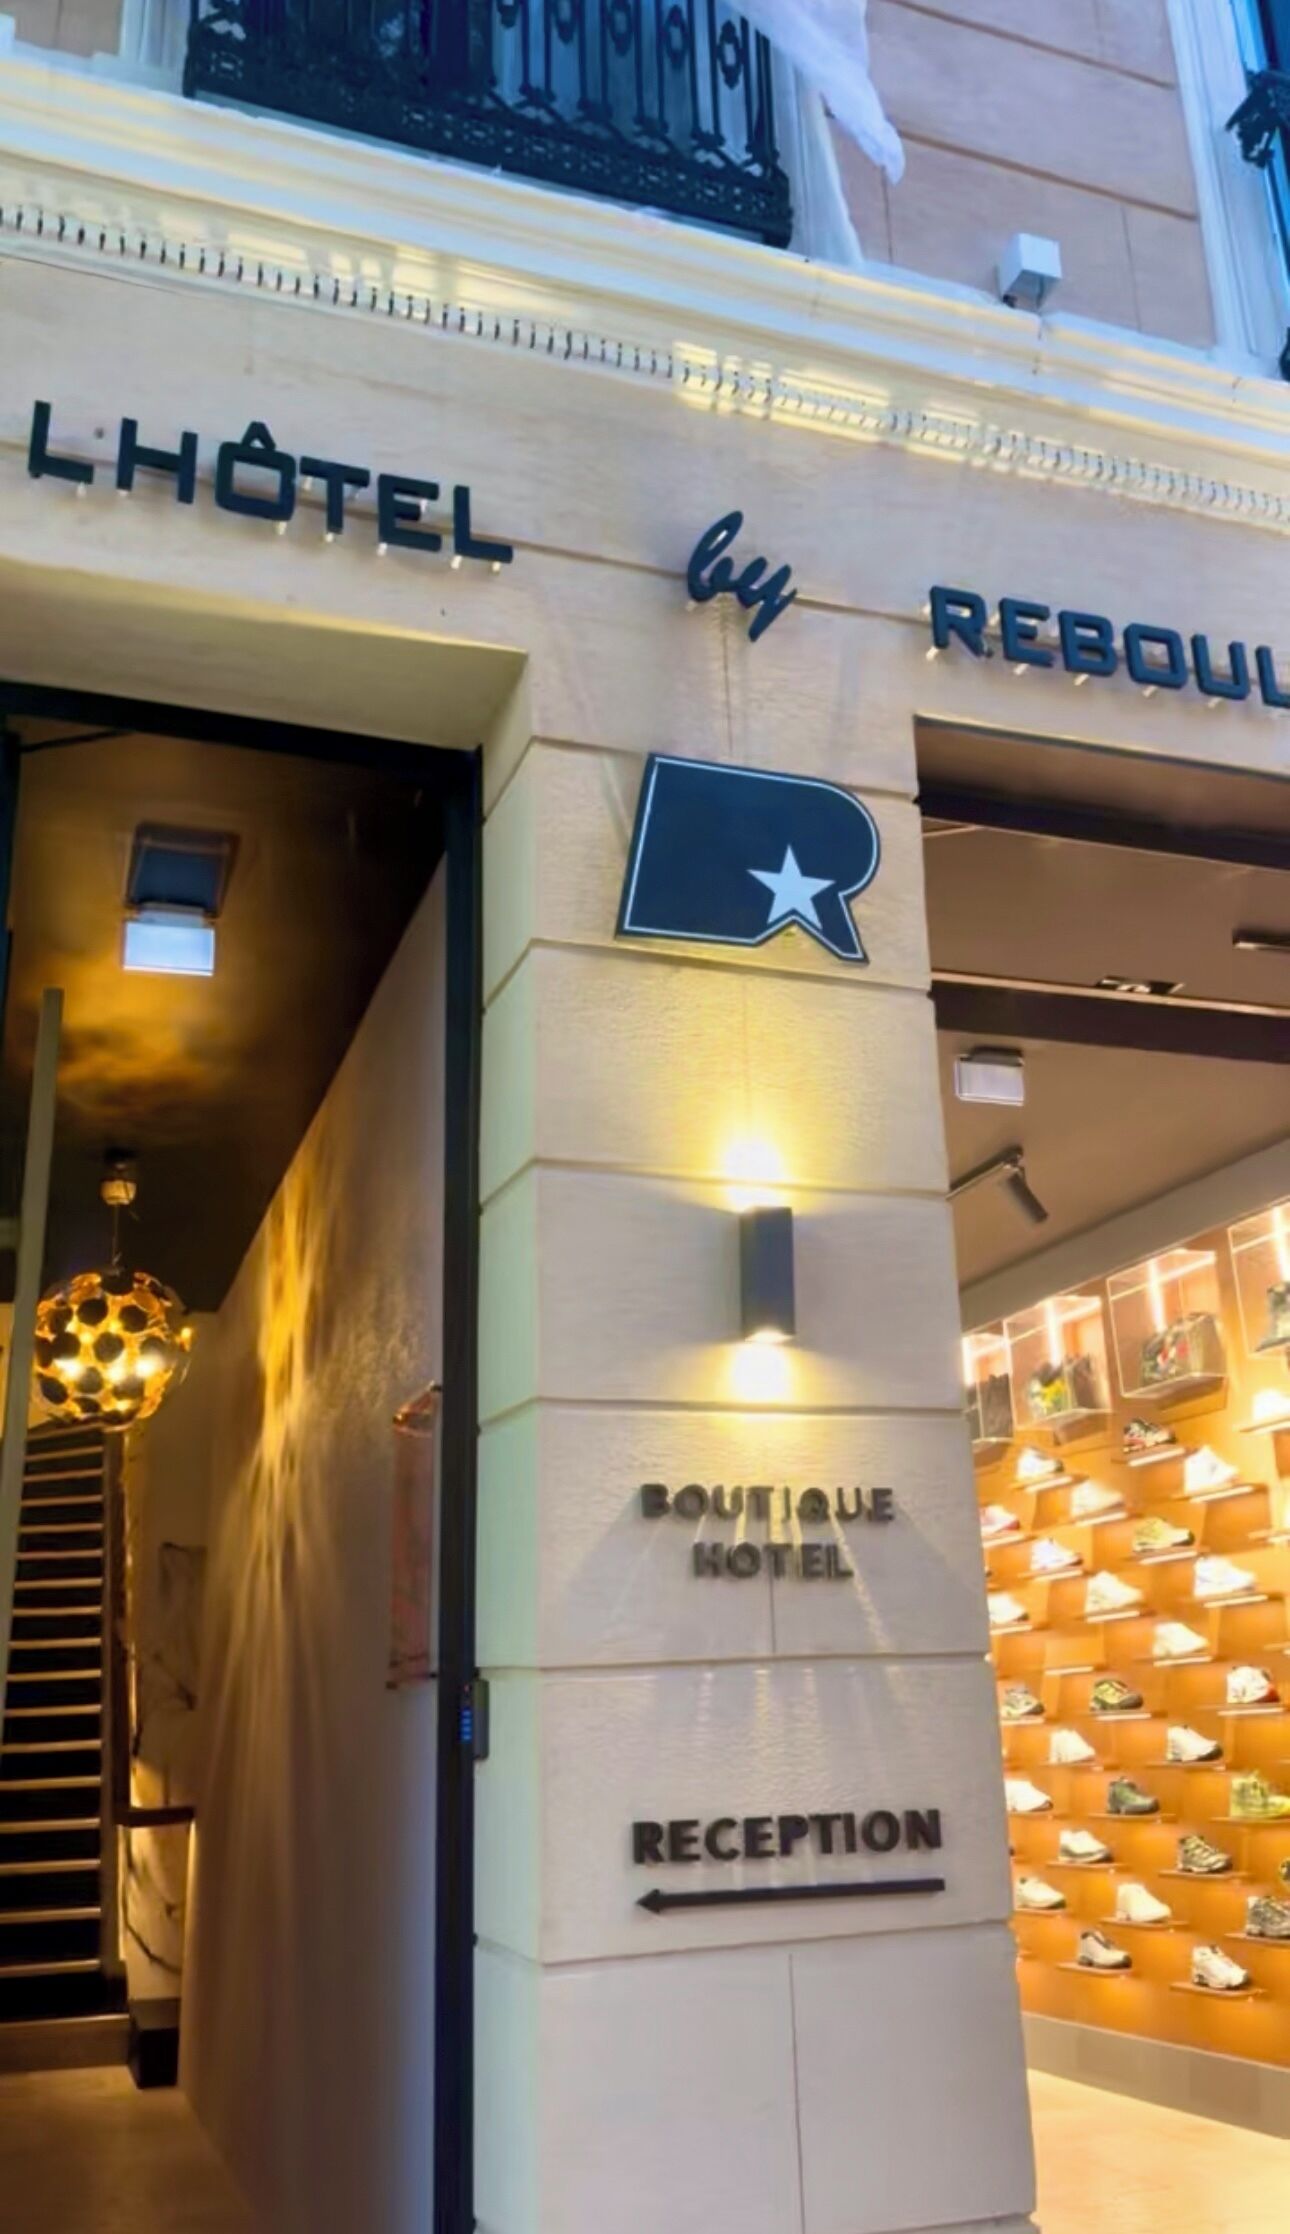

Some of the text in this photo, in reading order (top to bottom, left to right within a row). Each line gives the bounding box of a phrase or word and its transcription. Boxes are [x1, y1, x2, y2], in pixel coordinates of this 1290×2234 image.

[687, 510, 797, 642] by
[640, 1484, 895, 1522] BOUTIQUE
[692, 1542, 854, 1580] HOTEL
[632, 1808, 943, 1864] RECEPTION
